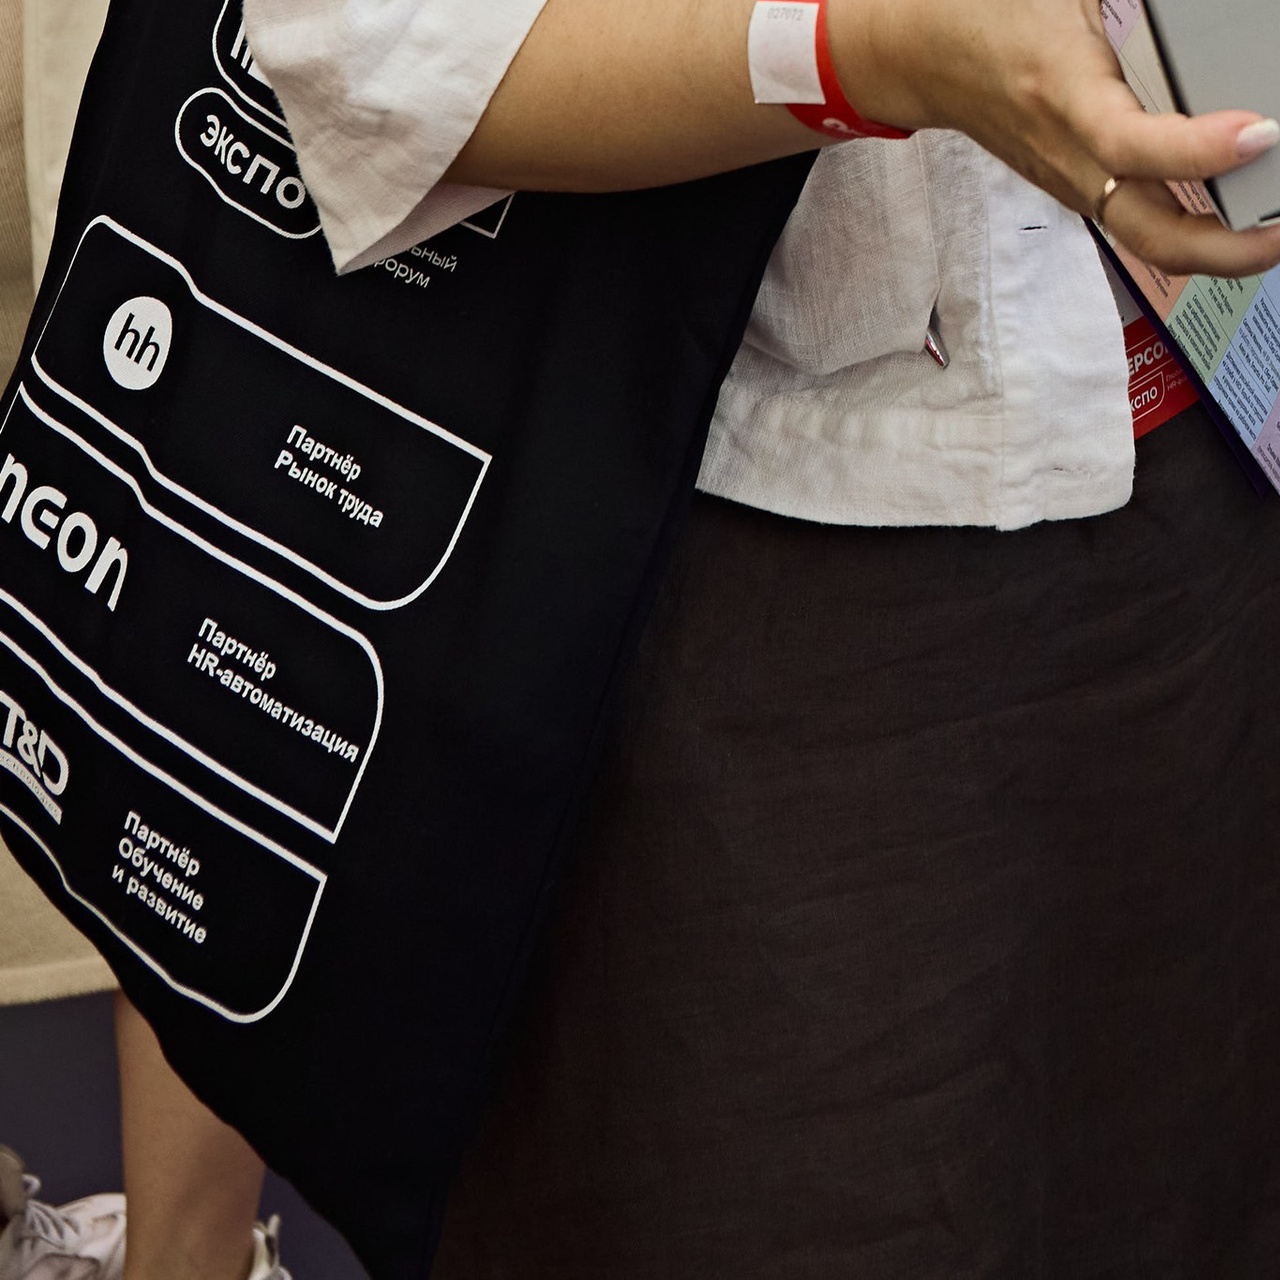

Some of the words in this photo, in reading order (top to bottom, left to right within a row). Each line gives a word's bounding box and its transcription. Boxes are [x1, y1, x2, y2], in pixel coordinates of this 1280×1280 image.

[200, 114, 306, 209] ЭКСПО
[114, 313, 160, 372] hh
[274, 449, 337, 500] Рынок
[338, 488, 384, 528] труда
[286, 424, 361, 482] Партнёр
[198, 617, 277, 681] Партнёр
[187, 643, 360, 763] HR-автоматизация
[118, 837, 204, 911] Обучение
[124, 810, 201, 877] Партнёр
[112, 864, 125, 883] и
[126, 876, 208, 944] развитие
